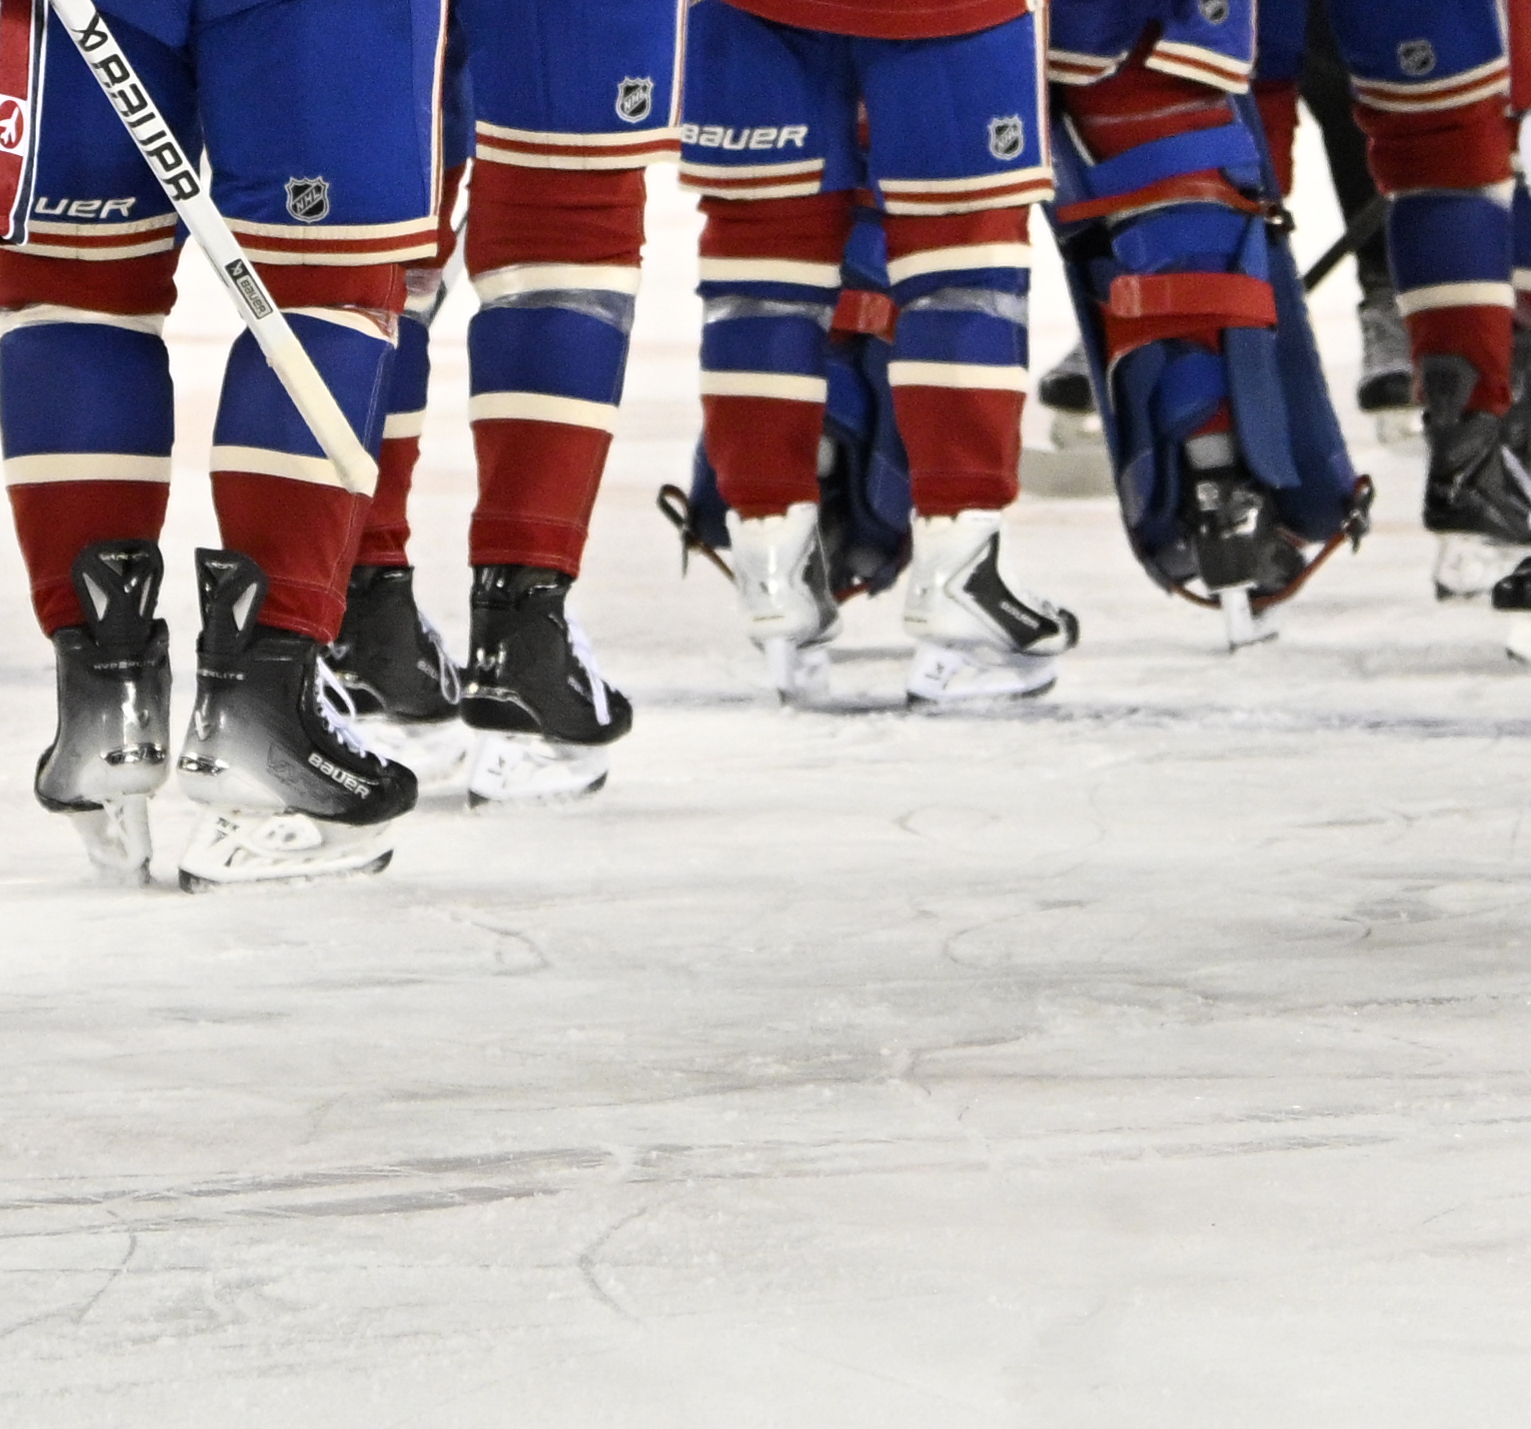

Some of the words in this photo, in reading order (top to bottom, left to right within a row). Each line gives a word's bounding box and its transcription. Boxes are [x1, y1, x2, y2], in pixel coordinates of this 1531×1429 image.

[679, 121, 809, 153] BAUER
[34, 195, 138, 221] UER
[294, 188, 322, 215] NHL
[239, 275, 267, 318] BAUER
[307, 751, 371, 800] BAUER
